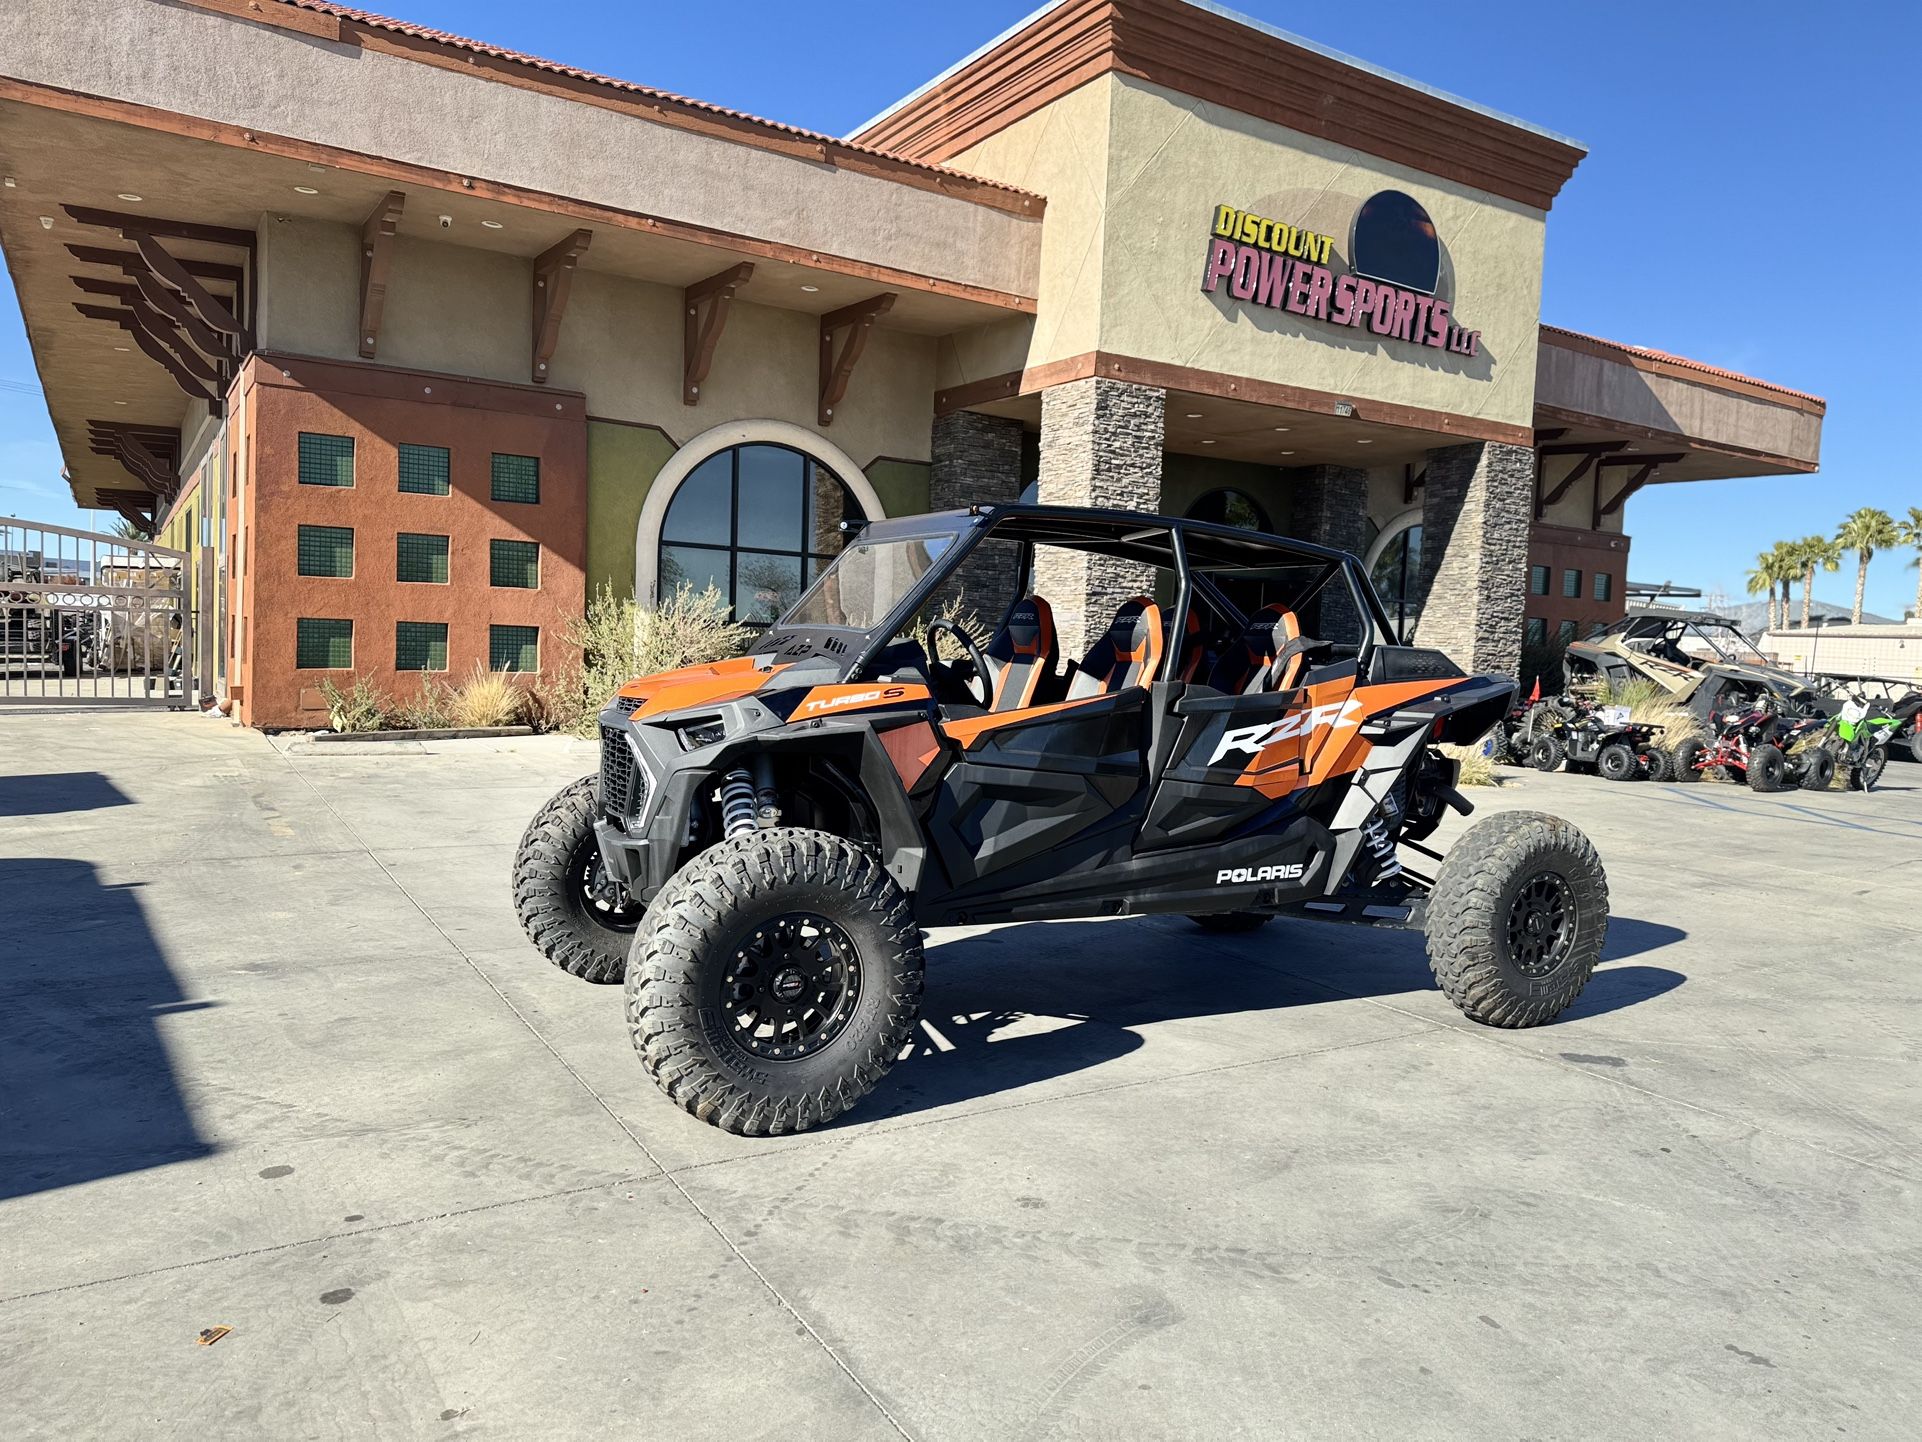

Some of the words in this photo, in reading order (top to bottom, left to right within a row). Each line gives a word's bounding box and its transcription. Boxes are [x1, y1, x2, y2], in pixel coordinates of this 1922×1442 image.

[1213, 204, 1334, 265] DISCOUNT
[1202, 238, 1450, 348] POWERSPORTS
[1449, 325, 1481, 357] LLC
[806, 691, 882, 712] TURBO
[883, 687, 905, 699] S
[1207, 699, 1364, 767] RZR
[1216, 863, 1303, 884] POLARIS
